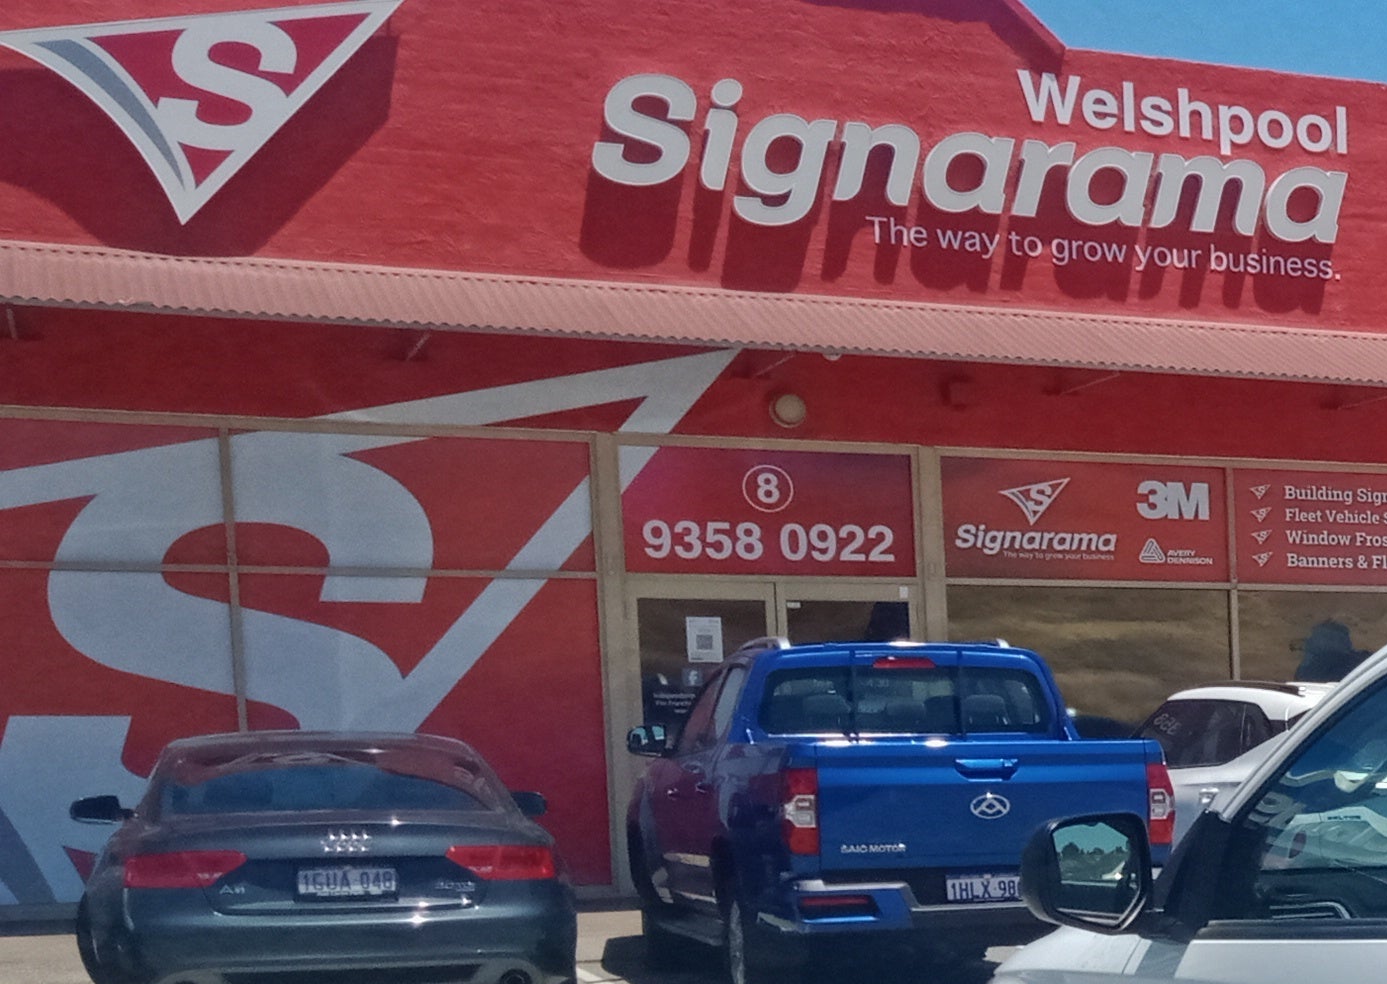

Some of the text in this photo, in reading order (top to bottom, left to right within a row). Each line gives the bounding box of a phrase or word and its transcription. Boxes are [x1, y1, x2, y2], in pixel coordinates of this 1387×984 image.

[1017, 68, 1349, 155] Welshpool
[591, 73, 1349, 245] Signarama
[866, 216, 1341, 282] The way to grow your business.
[756, 473, 781, 504] 8
[1136, 480, 1210, 521] 3M
[1284, 485, 1353, 505] Building
[1285, 508, 1322, 522] Fleet
[1325, 510, 1380, 525] Vehicle
[642, 519, 895, 563] 9358 0922
[955, 523, 1117, 555] Signarama
[1167, 549, 1195, 558] AVERY
[1285, 530, 1351, 546] Window
[1167, 556, 1213, 566] DENNISON
[1287, 553, 1353, 569] Banners
[1357, 556, 1368, 569] &
